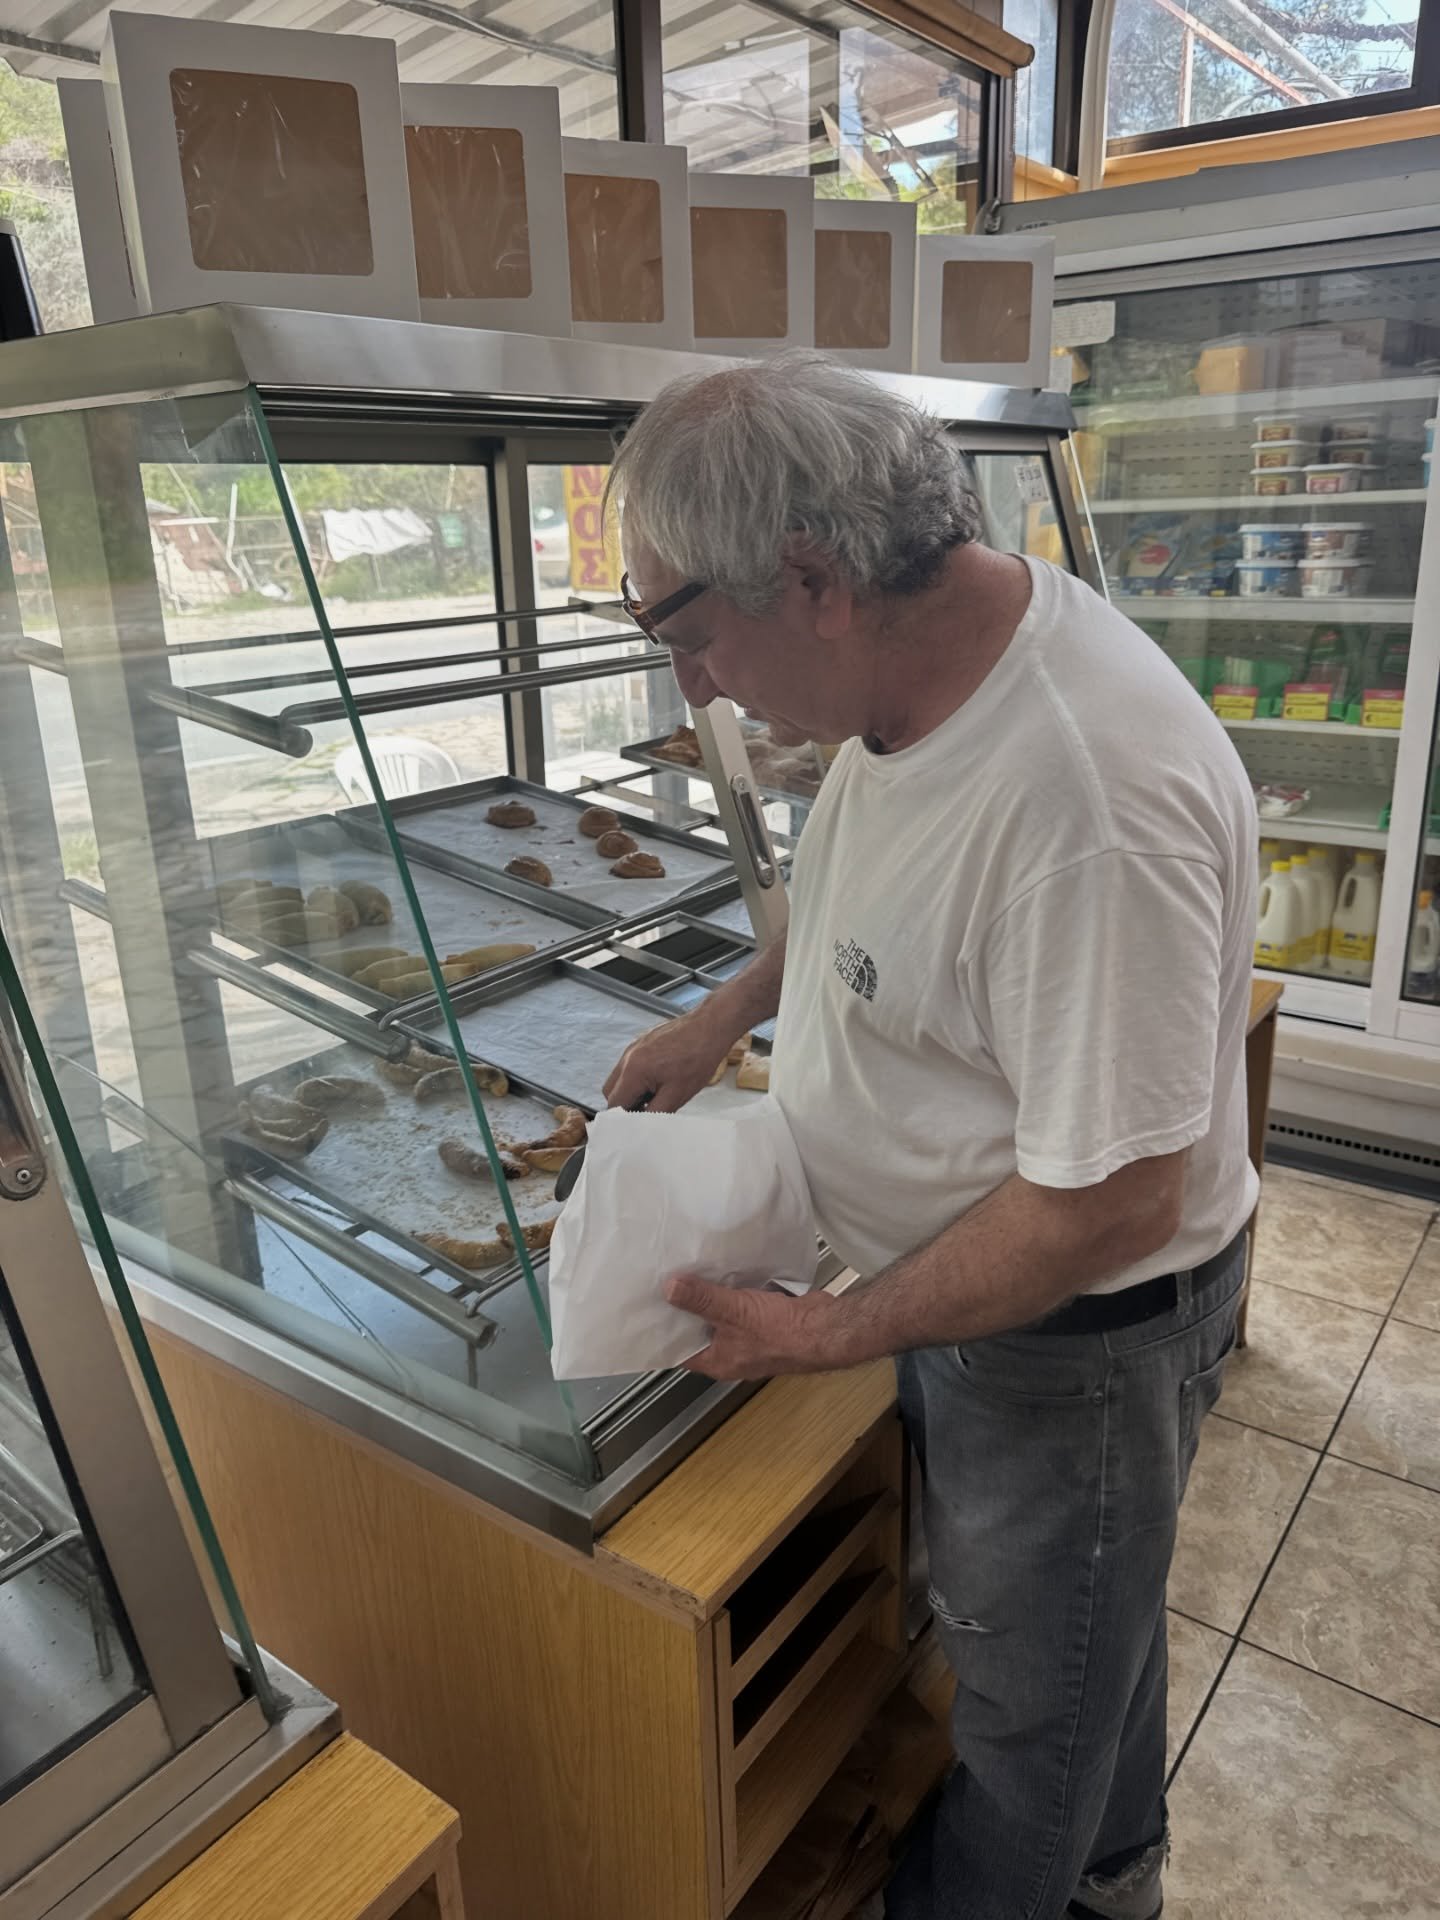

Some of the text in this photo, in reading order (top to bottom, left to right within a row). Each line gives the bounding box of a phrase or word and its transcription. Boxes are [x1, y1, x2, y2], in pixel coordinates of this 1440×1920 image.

[833, 938, 860, 975] NORTH
[847, 938, 865, 963] THE
[833, 957, 853, 986] FACE
